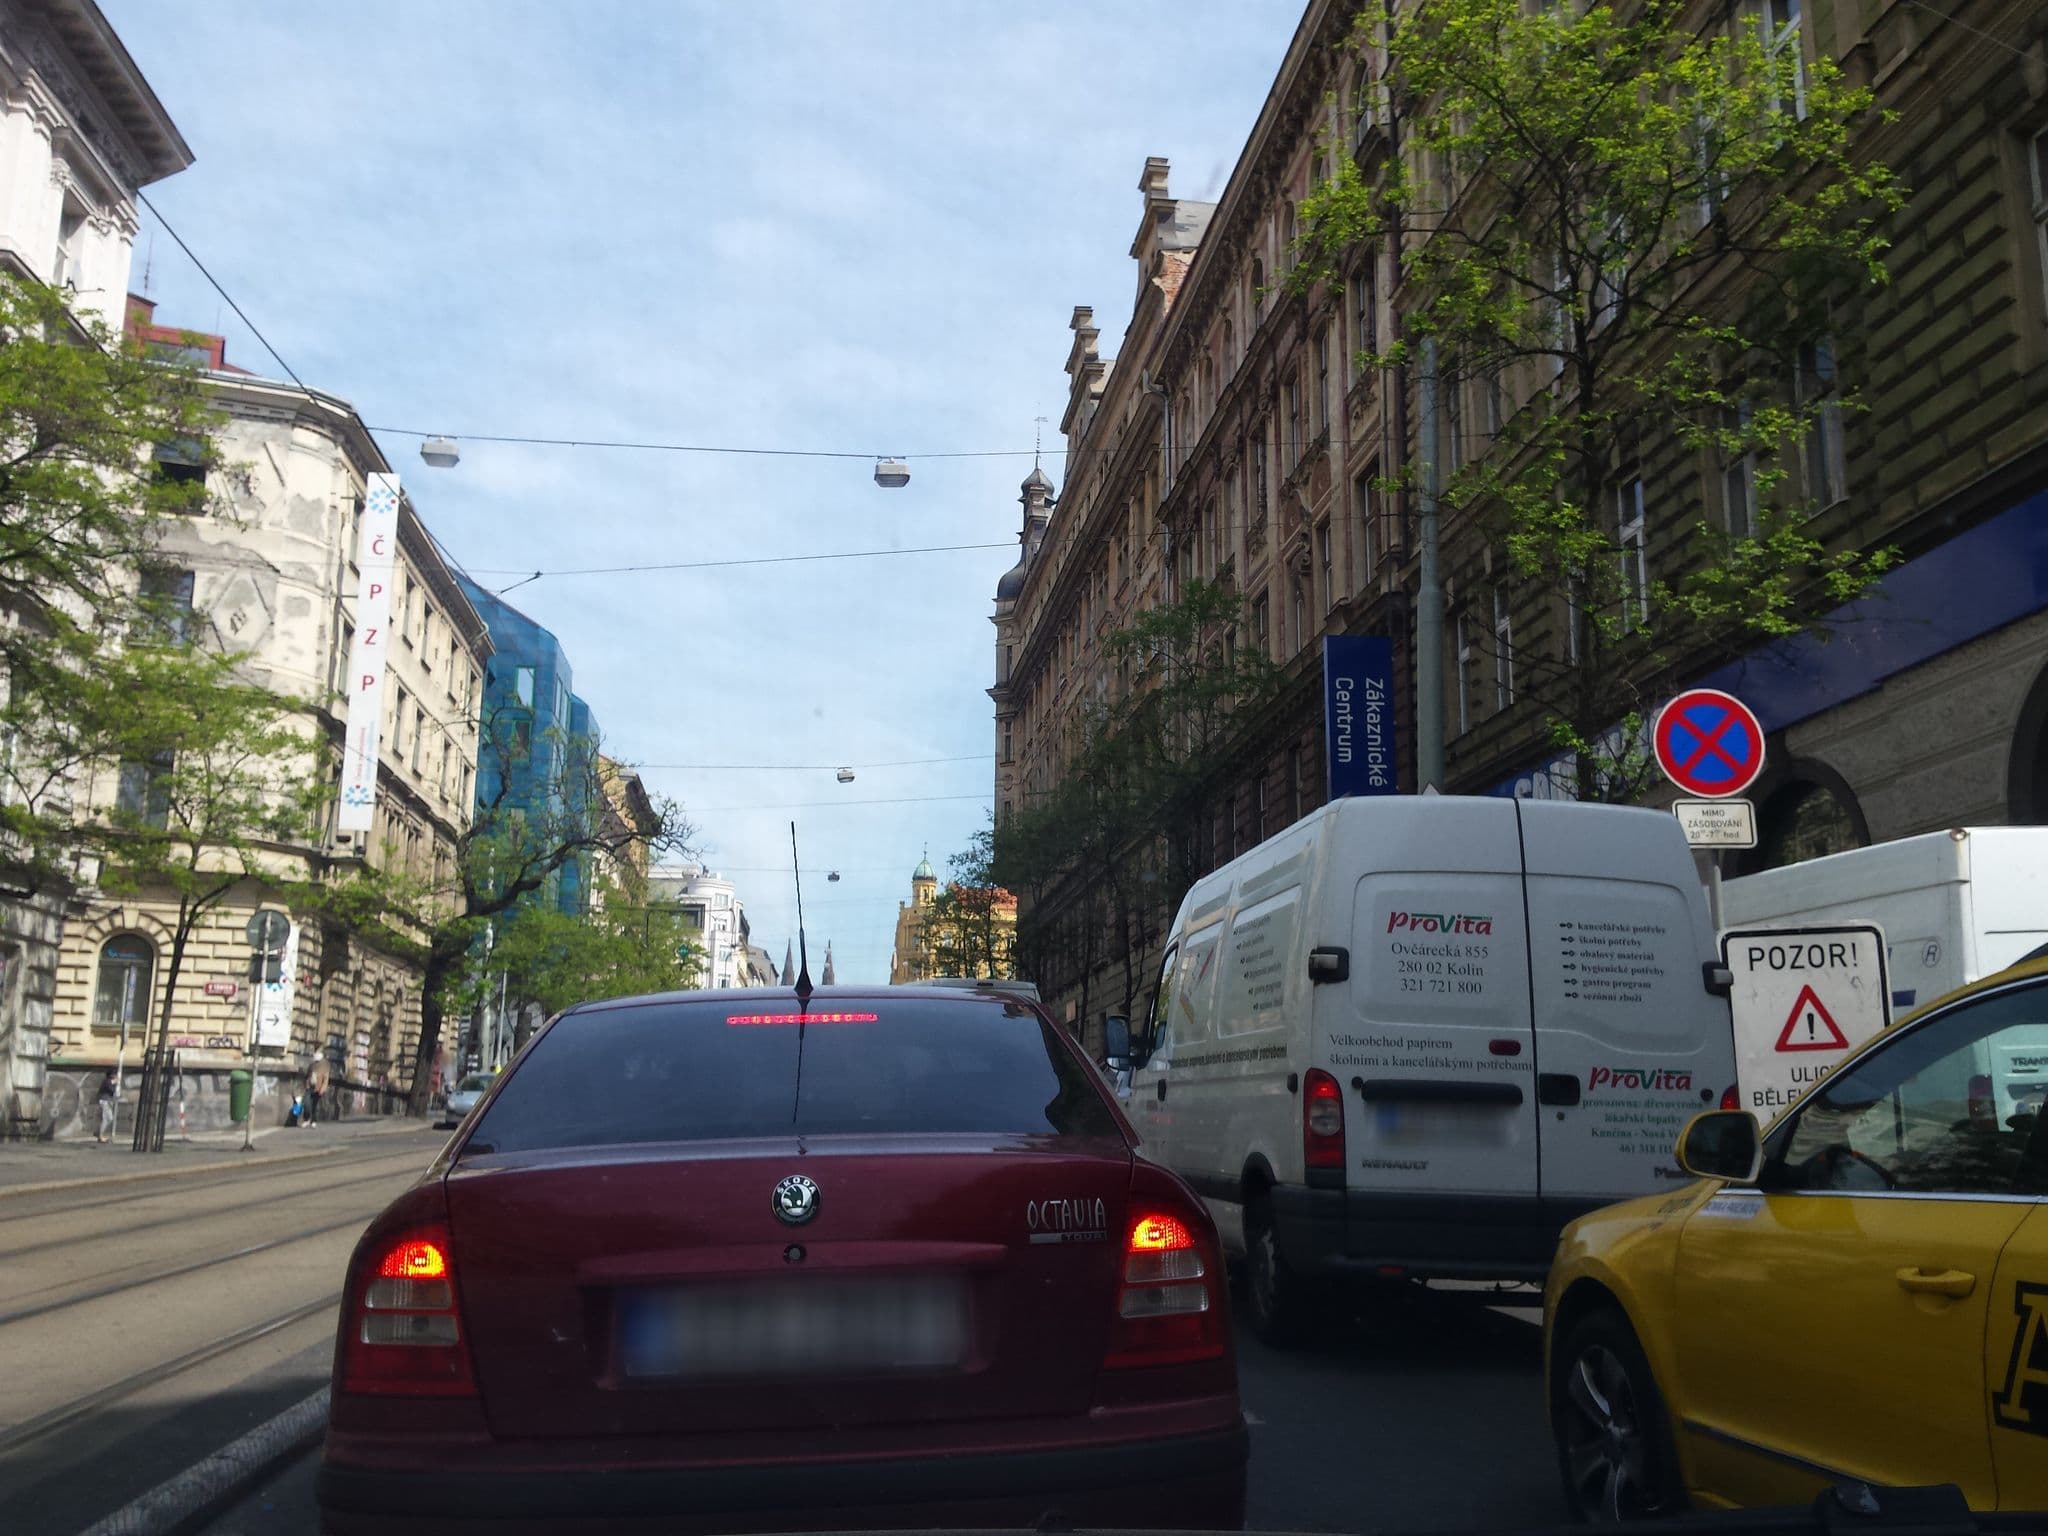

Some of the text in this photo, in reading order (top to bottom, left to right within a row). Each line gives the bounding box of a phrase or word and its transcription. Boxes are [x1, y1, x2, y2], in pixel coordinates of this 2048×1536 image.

[1335, 677, 1354, 763] Centrum
[1365, 677, 1388, 787] Zákaznické
[1702, 809, 1725, 817] MIMO
[1632, 923, 1666, 935] potřeby
[1579, 935, 1642, 947] školní potřeby
[1391, 942, 1489, 959] Ovčárecká 855
[1748, 942, 1858, 971] POZOR!
[1398, 960, 1423, 973] 280
[1426, 962, 1442, 974] 02
[1630, 965, 1665, 977] potřeby
[1400, 978, 1482, 994] 321 721 800
[1582, 978, 1652, 990] gastro program
[1329, 1034, 1404, 1048] Velkoobchod
[1382, 1058, 1389, 1067] a
[1027, 1197, 1106, 1231] OCTAVIA
